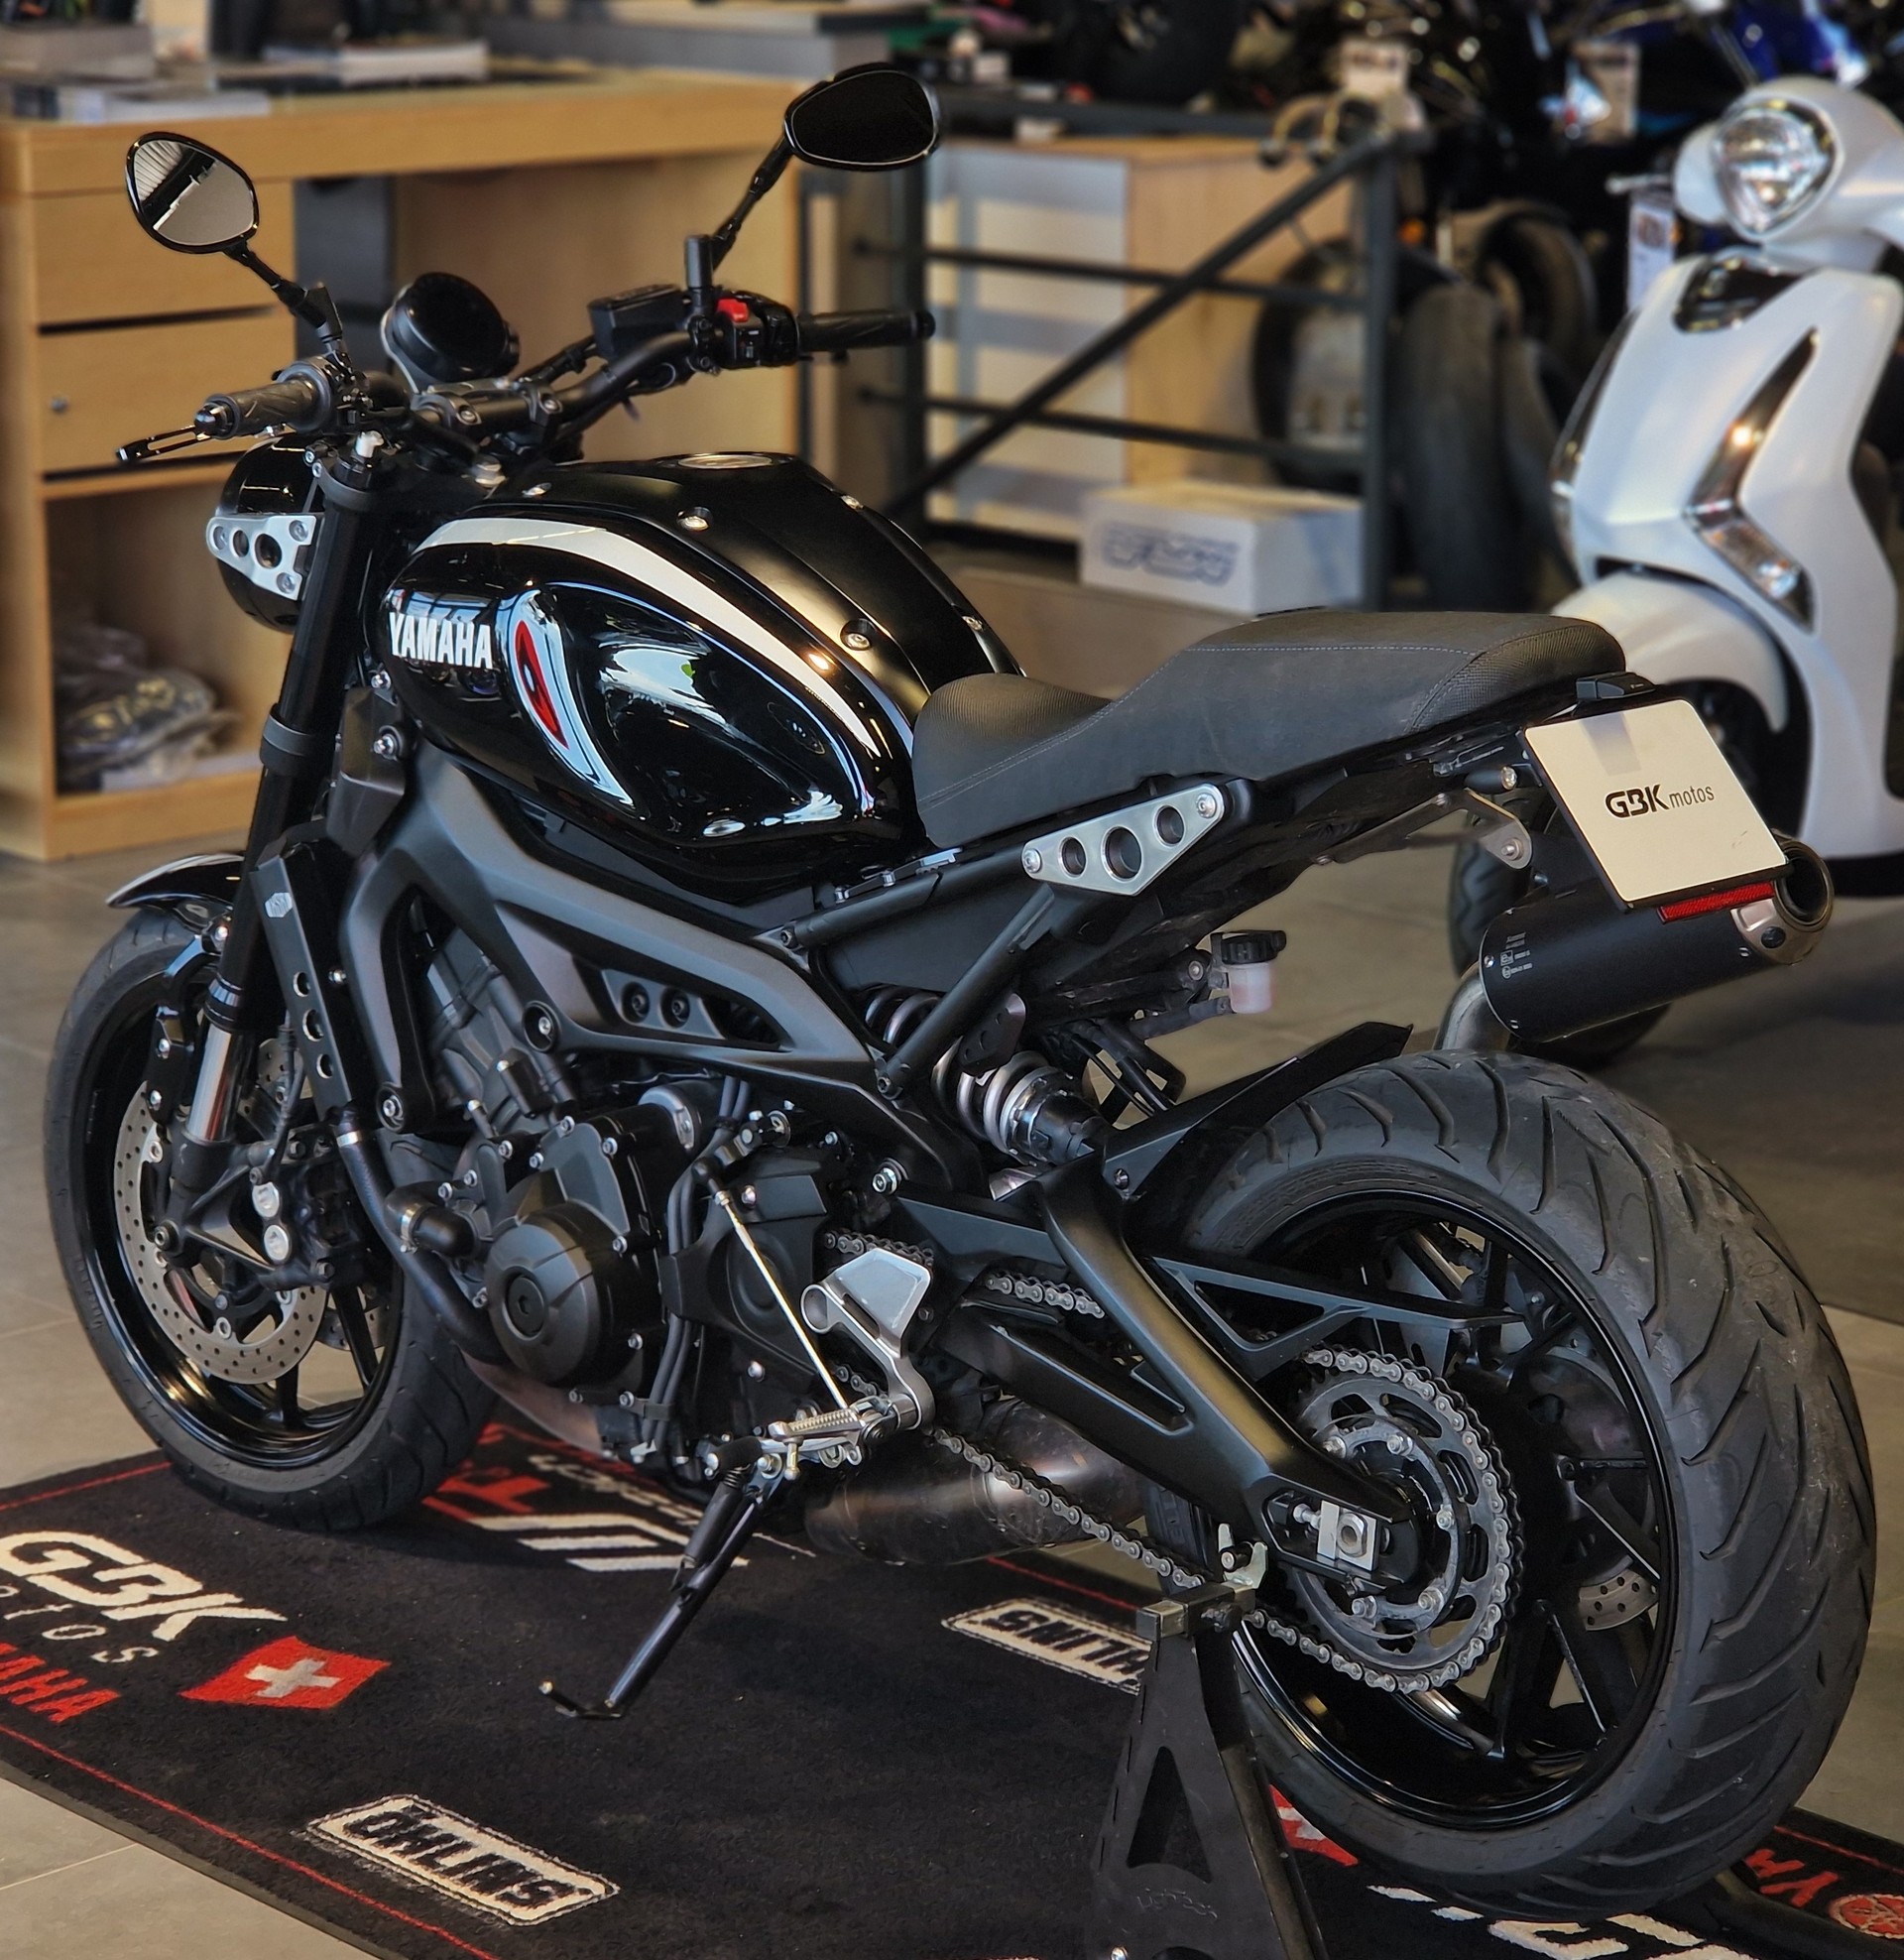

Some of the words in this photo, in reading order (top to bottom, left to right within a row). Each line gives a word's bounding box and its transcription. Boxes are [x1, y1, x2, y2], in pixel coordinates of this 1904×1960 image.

[389, 611, 493, 670] YAMAHA
[1605, 784, 1670, 818] GBK
[1669, 786, 1715, 808] motos
[0, 1531, 289, 1643] GBK
[980, 1610, 1149, 1685] HLINS
